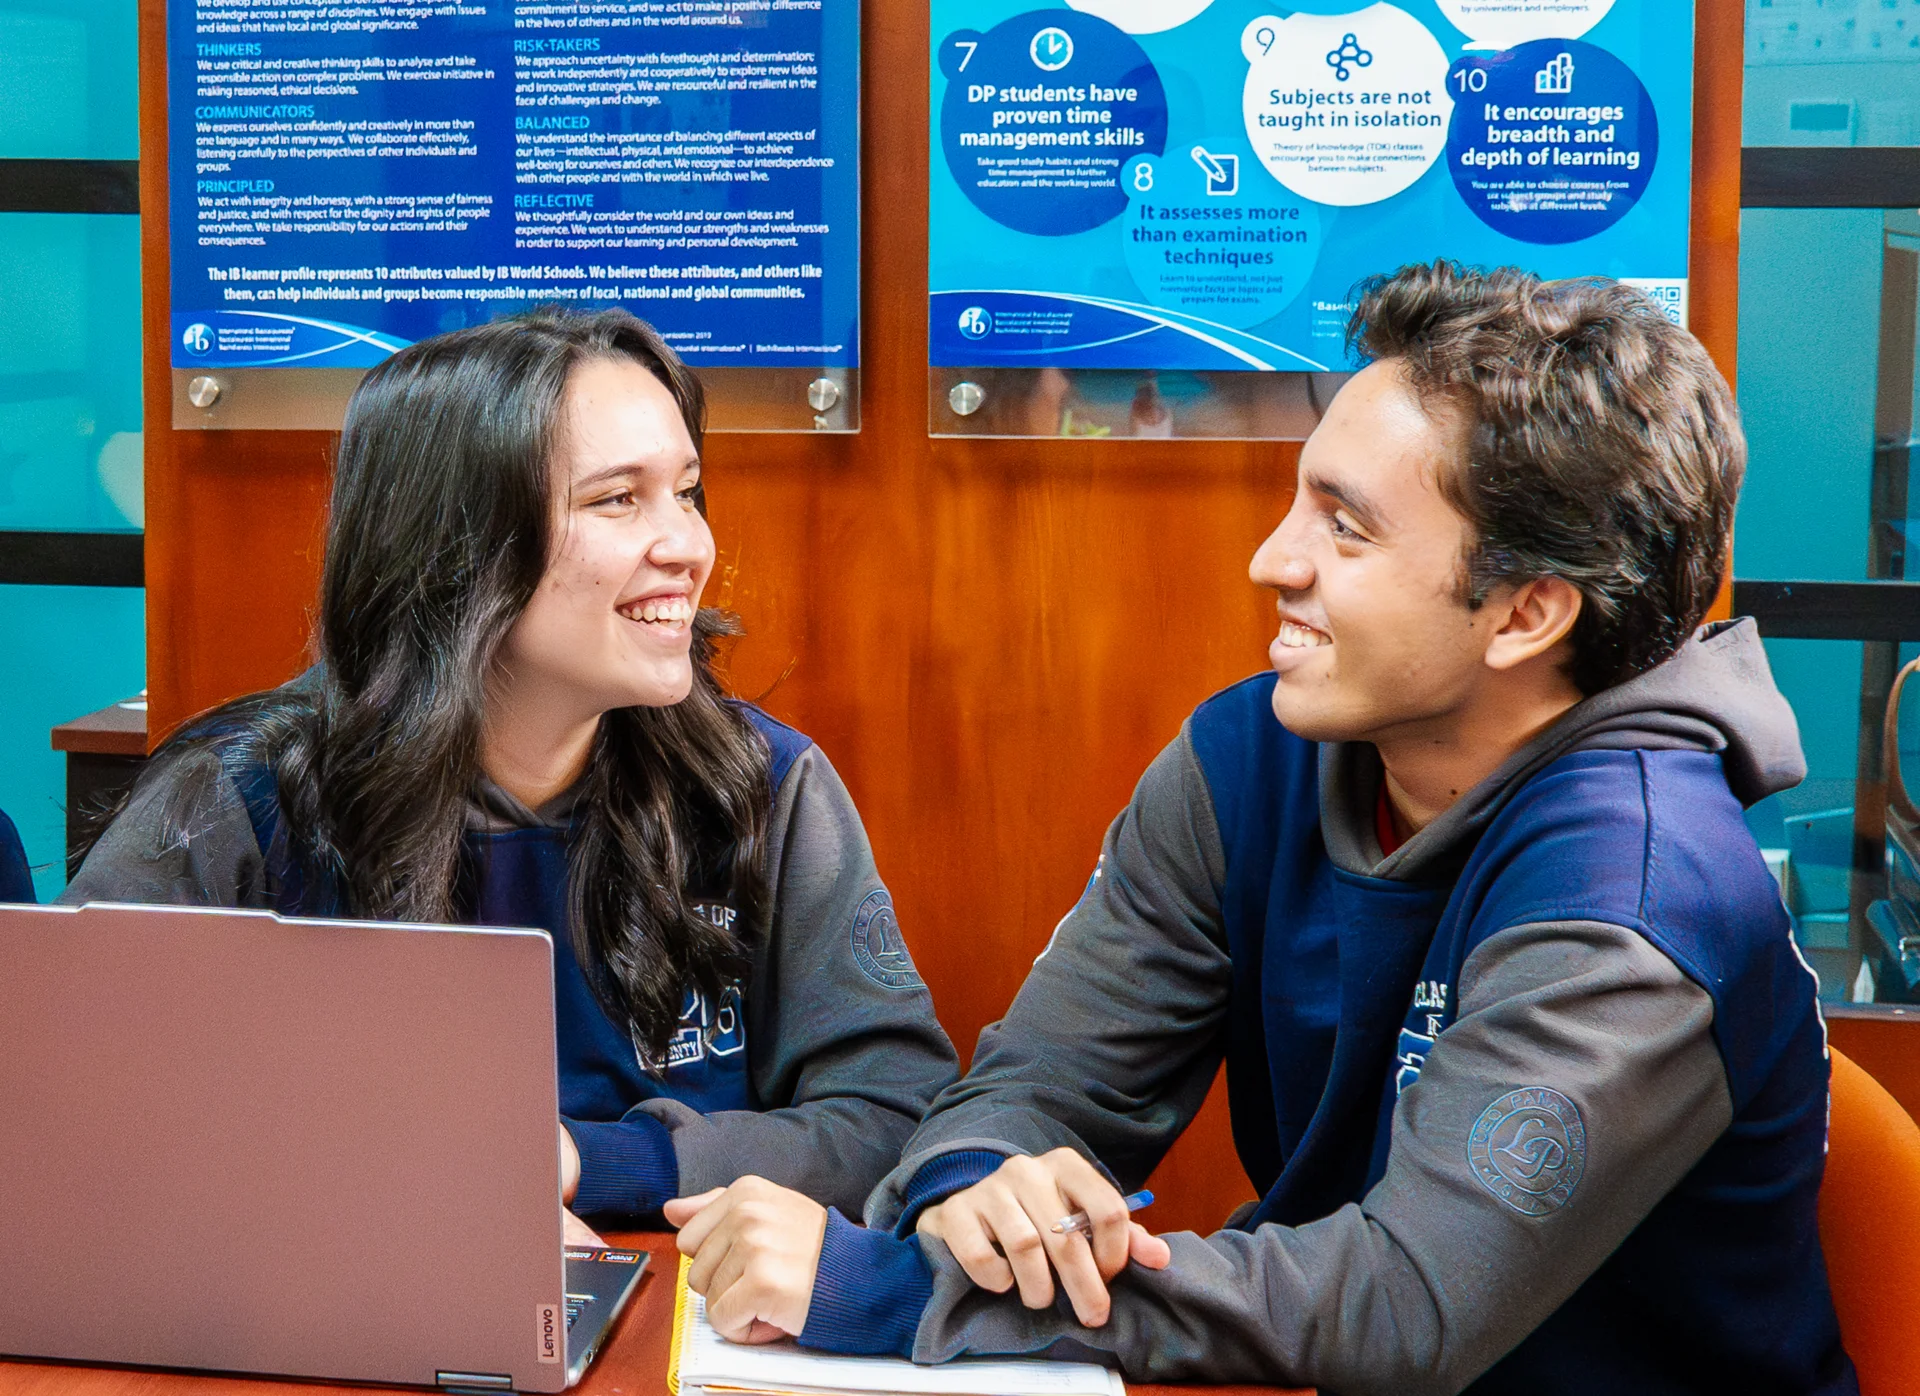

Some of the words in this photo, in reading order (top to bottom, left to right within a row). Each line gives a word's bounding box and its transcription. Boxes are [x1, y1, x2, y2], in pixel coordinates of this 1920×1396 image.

[197, 43, 261, 55] THINKERS
[514, 38, 600, 51] RISK-TAKERS
[1256, 27, 1276, 56] 9
[954, 42, 978, 72] 7
[1453, 69, 1488, 93] 10
[197, 84, 233, 99] making
[235, 83, 280, 97] reasoned,
[282, 83, 313, 95] ethical
[314, 82, 358, 95] decisions.
[967, 83, 996, 101] DP
[999, 83, 1086, 101] students
[1089, 83, 1138, 101] have
[1270, 88, 1355, 108] Subjects
[1358, 92, 1393, 104] are
[1396, 88, 1431, 104] not
[515, 94, 536, 105] face
[537, 94, 548, 105] of
[550, 93, 601, 108] challenges
[603, 93, 622, 104] and
[623, 93, 661, 107] change.
[195, 105, 315, 118] COMMUNICATORS
[992, 110, 1062, 127] proven
[1065, 106, 1112, 123] time
[1258, 110, 1326, 131] taught
[1329, 110, 1350, 126] in
[1353, 110, 1441, 126] isolation
[1484, 102, 1500, 120] It
[1503, 107, 1624, 124] encourages
[515, 116, 590, 129] BALANCED
[959, 128, 1091, 149] management
[1094, 128, 1145, 145] skills
[1488, 124, 1570, 142] breadth
[1573, 124, 1614, 142] and
[1461, 147, 1524, 169] depth
[1527, 147, 1550, 164] of
[1554, 147, 1640, 169] learning
[197, 180, 274, 192] PRINCIPLED
[1134, 162, 1154, 192] 8
[198, 194, 213, 206] We
[214, 194, 229, 205] act
[230, 194, 251, 205] with
[252, 194, 291, 208] integrity
[293, 194, 311, 205] and
[313, 194, 352, 208] honesty,
[354, 194, 375, 205] with
[376, 196, 382, 204] a
[384, 193, 415, 207] strong
[416, 196, 443, 204] sense
[444, 193, 455, 204] of
[456, 193, 492, 204] fairness
[514, 193, 594, 207] REFLECTIVE
[515, 210, 531, 221] We
[533, 209, 594, 224] thoughtfully
[596, 209, 637, 220] consider
[639, 209, 656, 220] the
[657, 209, 685, 220] world
[687, 209, 706, 220] and
[707, 212, 724, 220] our
[725, 211, 747, 220] own
[748, 208, 774, 219] ideas
[775, 208, 794, 219] and
[1139, 203, 1155, 219] It
[1158, 207, 1243, 219] assesses
[1246, 207, 1300, 219] more
[516, 236, 524, 247] in
[526, 236, 552, 247] order
[554, 236, 564, 247] to
[566, 236, 604, 250] support
[605, 239, 622, 247] our
[624, 236, 664, 250] learning
[666, 235, 685, 247] and
[686, 235, 728, 250] personal
[730, 235, 798, 249] development.
[1131, 226, 1178, 242] than
[1181, 226, 1308, 242] examination
[1164, 247, 1274, 268] techniques
[208, 266, 227, 280] The
[228, 265, 240, 280] IB
[241, 265, 279, 280] learner
[281, 265, 316, 283] profile
[317, 265, 373, 283] represents
[374, 265, 388, 279] 10
[389, 265, 442, 279] attributes
[444, 264, 480, 279] valued
[482, 264, 495, 282] by
[497, 264, 509, 279] IB
[510, 264, 542, 278] World
[543, 264, 587, 278] Schools.
[588, 264, 606, 278] We
[607, 264, 647, 278] believe
[648, 264, 679, 278] these
[680, 264, 738, 280] attributes,
[740, 264, 762, 278] and
[764, 263, 799, 278] others
[801, 263, 822, 277] like
[224, 286, 255, 302] them,
[256, 290, 275, 299] can
[277, 286, 300, 303] help
[302, 286, 360, 299] individuals
[361, 286, 382, 299] and
[383, 289, 420, 303] groups
[421, 285, 463, 299] become
[465, 286, 526, 302] responsible
[528, 284, 577, 298] members
[579, 284, 591, 298] of
[592, 284, 621, 300] local,
[623, 284, 669, 298] national
[671, 284, 692, 298] and
[694, 284, 728, 301] global
[730, 284, 805, 298] communities.
[711, 904, 736, 930] OF
[542, 1308, 554, 1358] Lenovo
